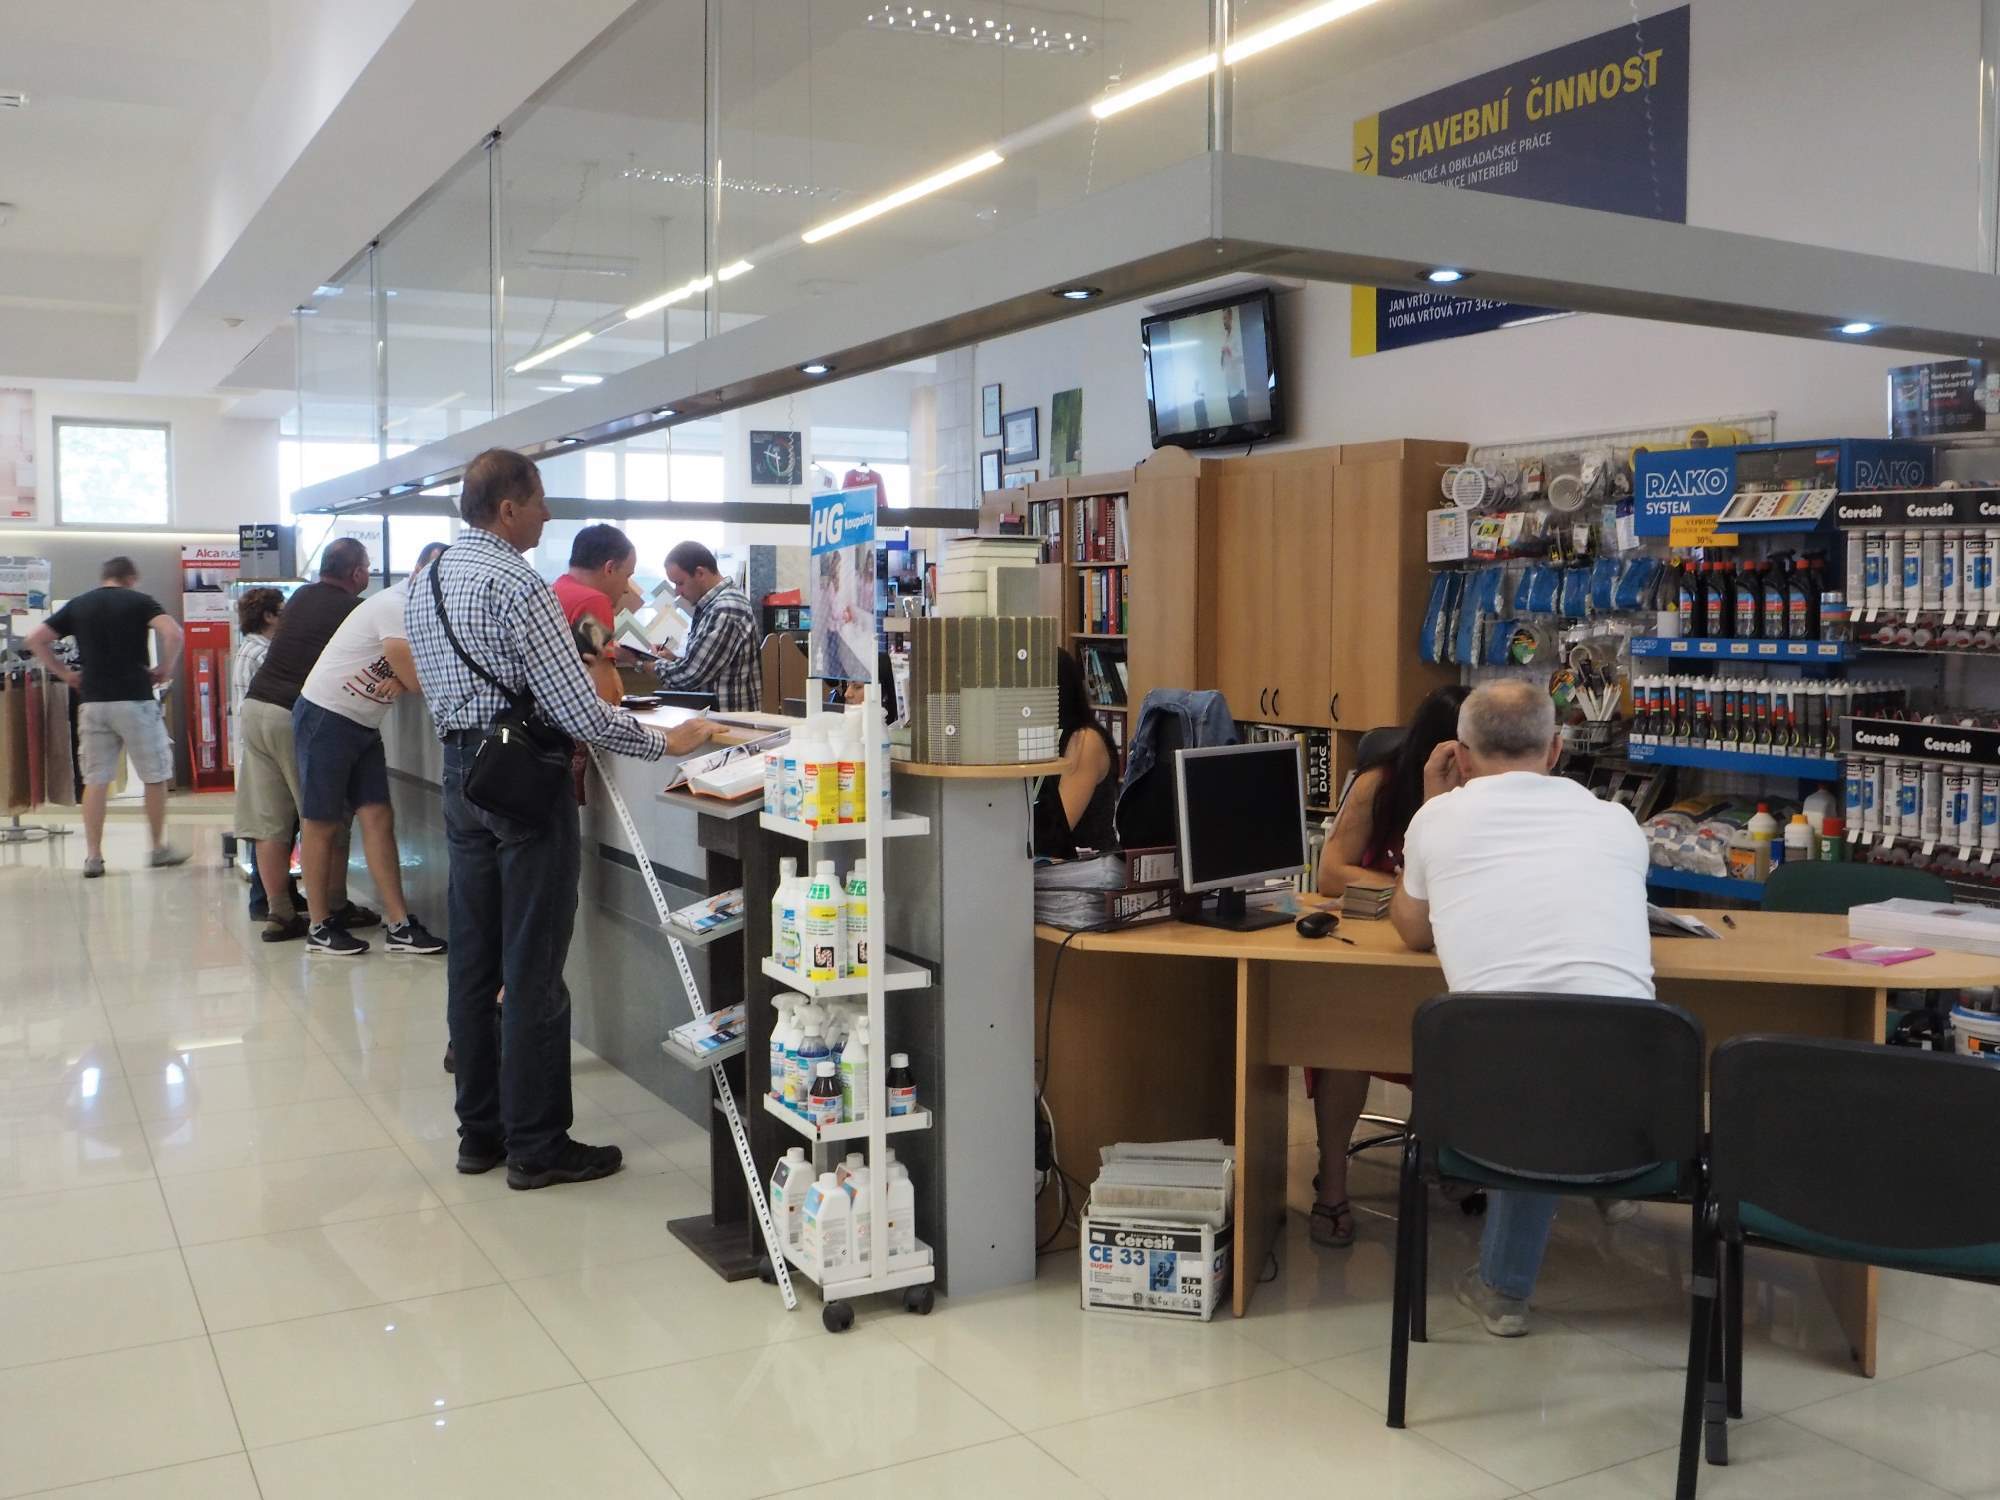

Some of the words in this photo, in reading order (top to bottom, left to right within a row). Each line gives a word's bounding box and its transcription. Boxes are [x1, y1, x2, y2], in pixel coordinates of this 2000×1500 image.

[1390, 87, 1512, 166] STAVEBNÍ
[1526, 49, 1663, 122] ČINNOST
[1440, 165, 1447, 176] A
[1448, 143, 1516, 173] OBKLADAČSKÉ
[1519, 132, 1552, 153] PRÁCE
[1467, 158, 1518, 184] INTERIÉRŮ
[1389, 297, 1405, 313] JAN
[1389, 311, 1416, 329] IVONA
[1455, 300, 1473, 315] 777
[1645, 468, 1727, 498] RAKO
[1855, 459, 1925, 488] RAKO
[1645, 501, 1691, 515] SYSTEM
[1838, 504, 1883, 519] Ceresit
[1907, 503, 1954, 518] Ceresit
[813, 502, 845, 548] HG
[196, 548, 220, 558] Alca
[1855, 730, 1900, 747] Ceresit
[1924, 736, 1972, 753] Ceresit
[1114, 1230, 1175, 1250] Ceresit
[1089, 1245, 1113, 1263] CE
[1120, 1248, 1145, 1266] 33
[1089, 1262, 1114, 1271] super
[1181, 1286, 1202, 1297] 5kg
